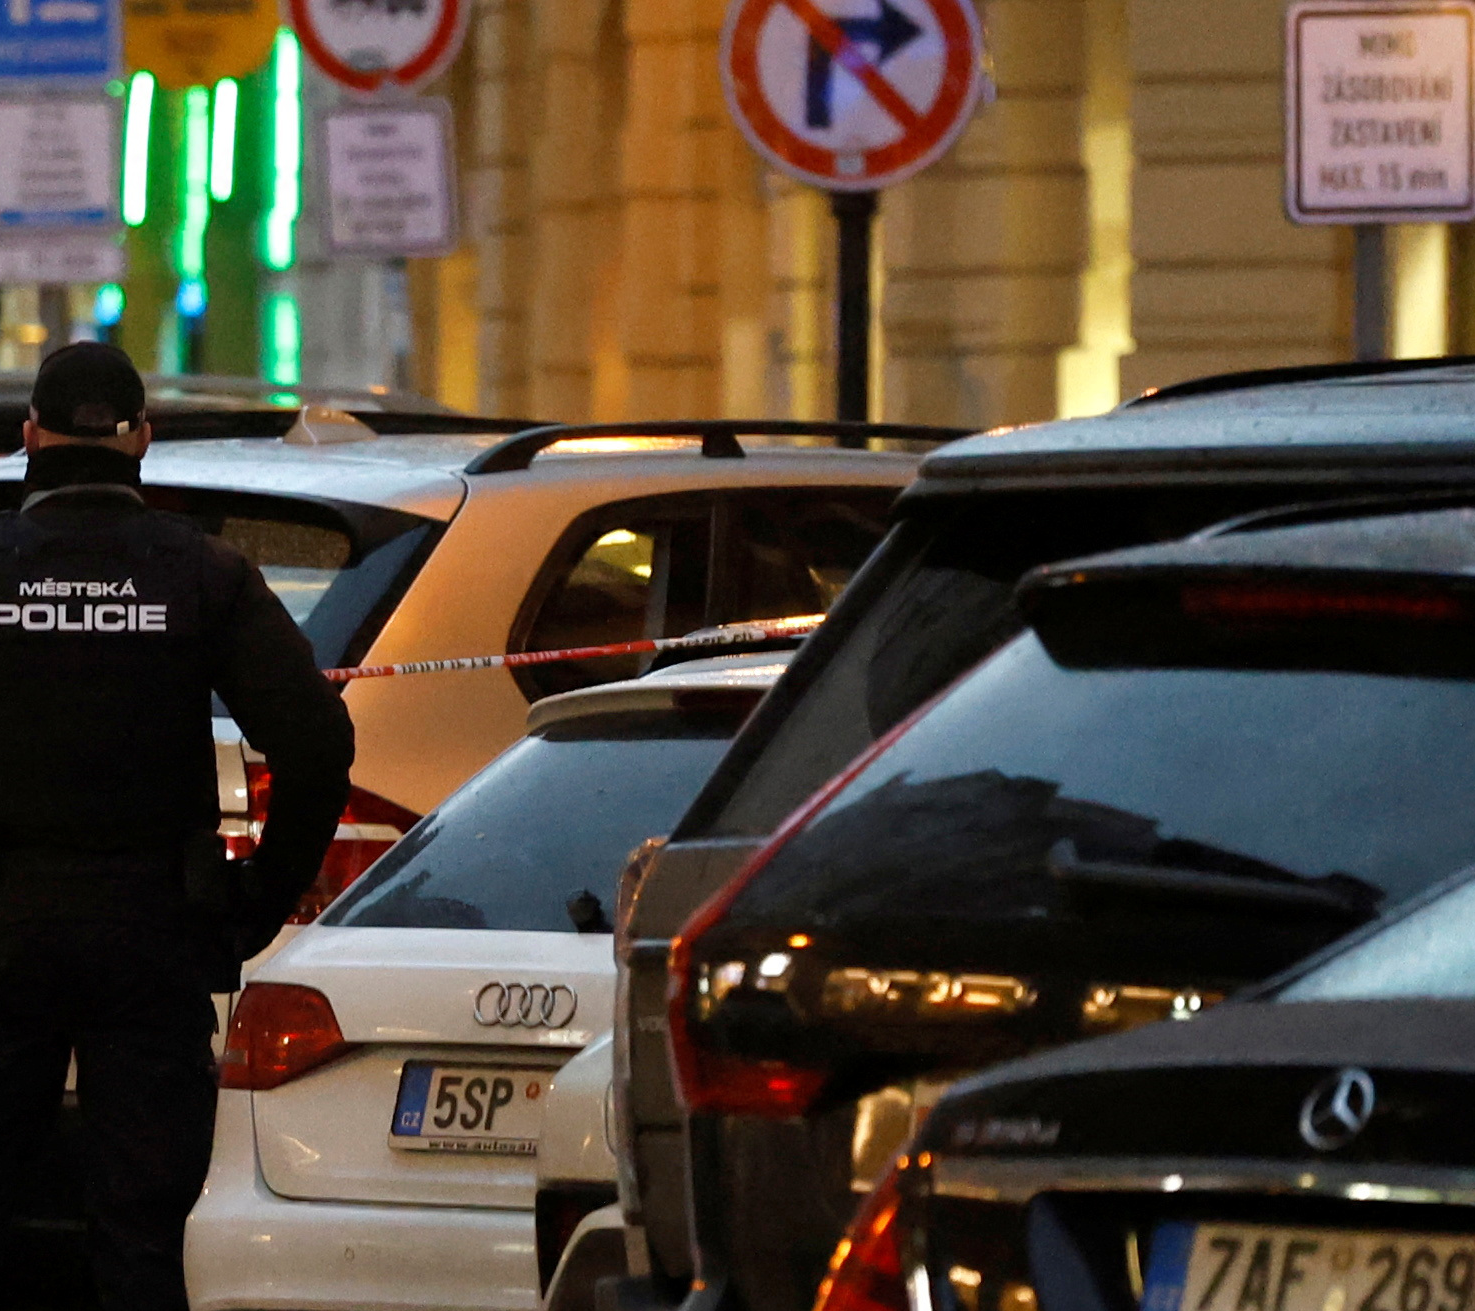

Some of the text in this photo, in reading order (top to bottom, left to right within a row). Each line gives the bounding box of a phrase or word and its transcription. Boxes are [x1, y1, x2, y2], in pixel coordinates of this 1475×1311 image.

[18, 577, 138, 598] MĚSTSKÁ
[433, 1076, 515, 1131] 5SP
[401, 1111, 421, 1128] CZ
